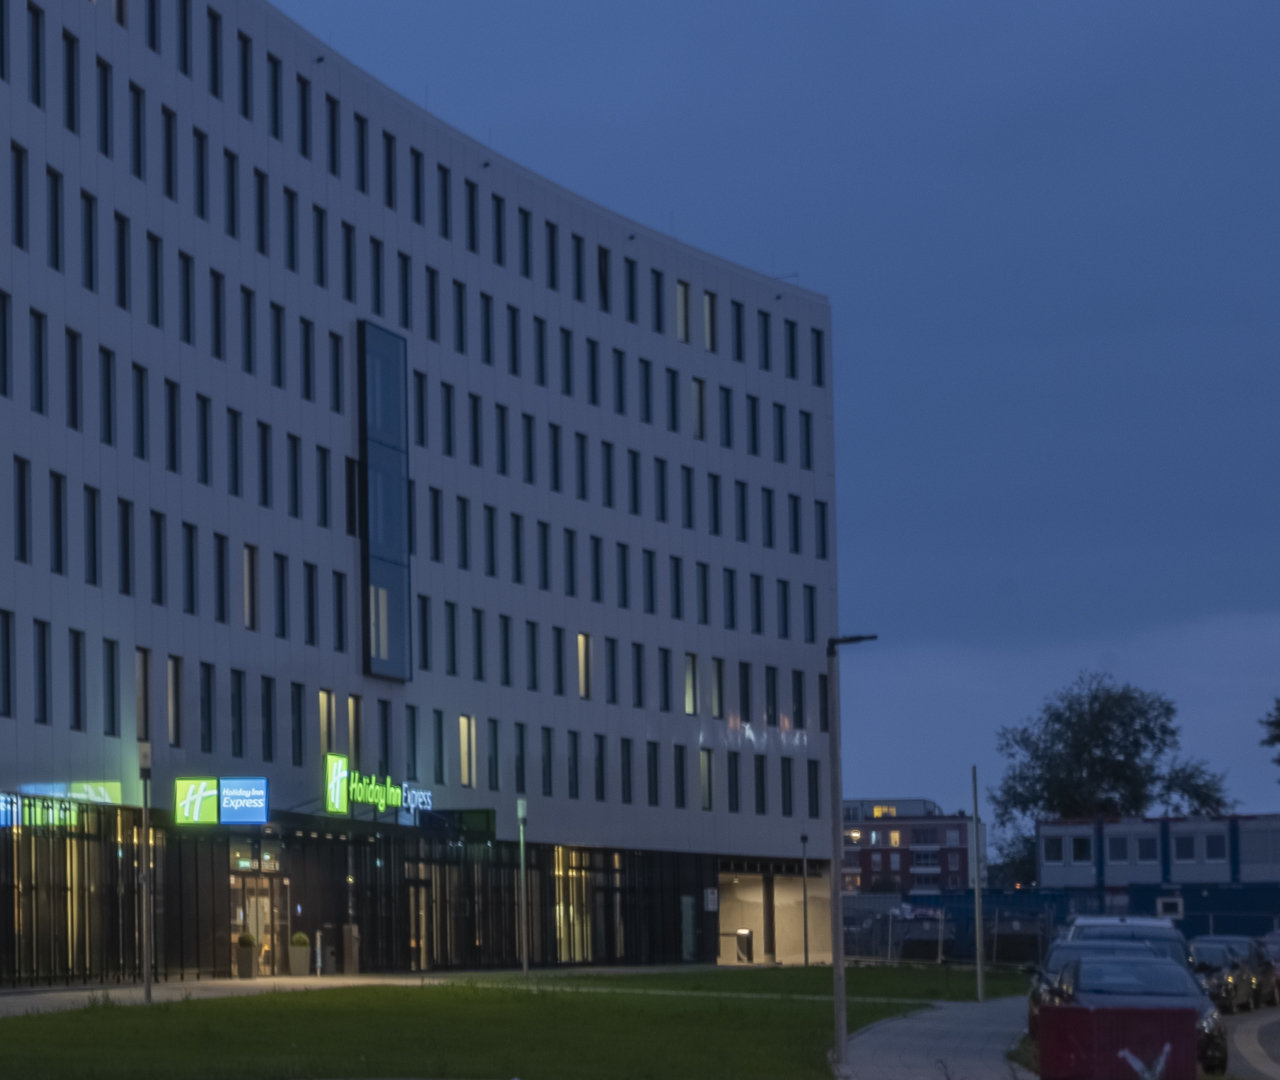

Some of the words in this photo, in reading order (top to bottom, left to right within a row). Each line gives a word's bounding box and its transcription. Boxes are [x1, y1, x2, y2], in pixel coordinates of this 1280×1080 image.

[222, 788, 250, 798] Holiday
[252, 788, 264, 796] Inn
[349, 770, 386, 813] Holiday
[387, 775, 402, 807] Inn
[402, 781, 432, 814] Express
[222, 797, 265, 810] Express
